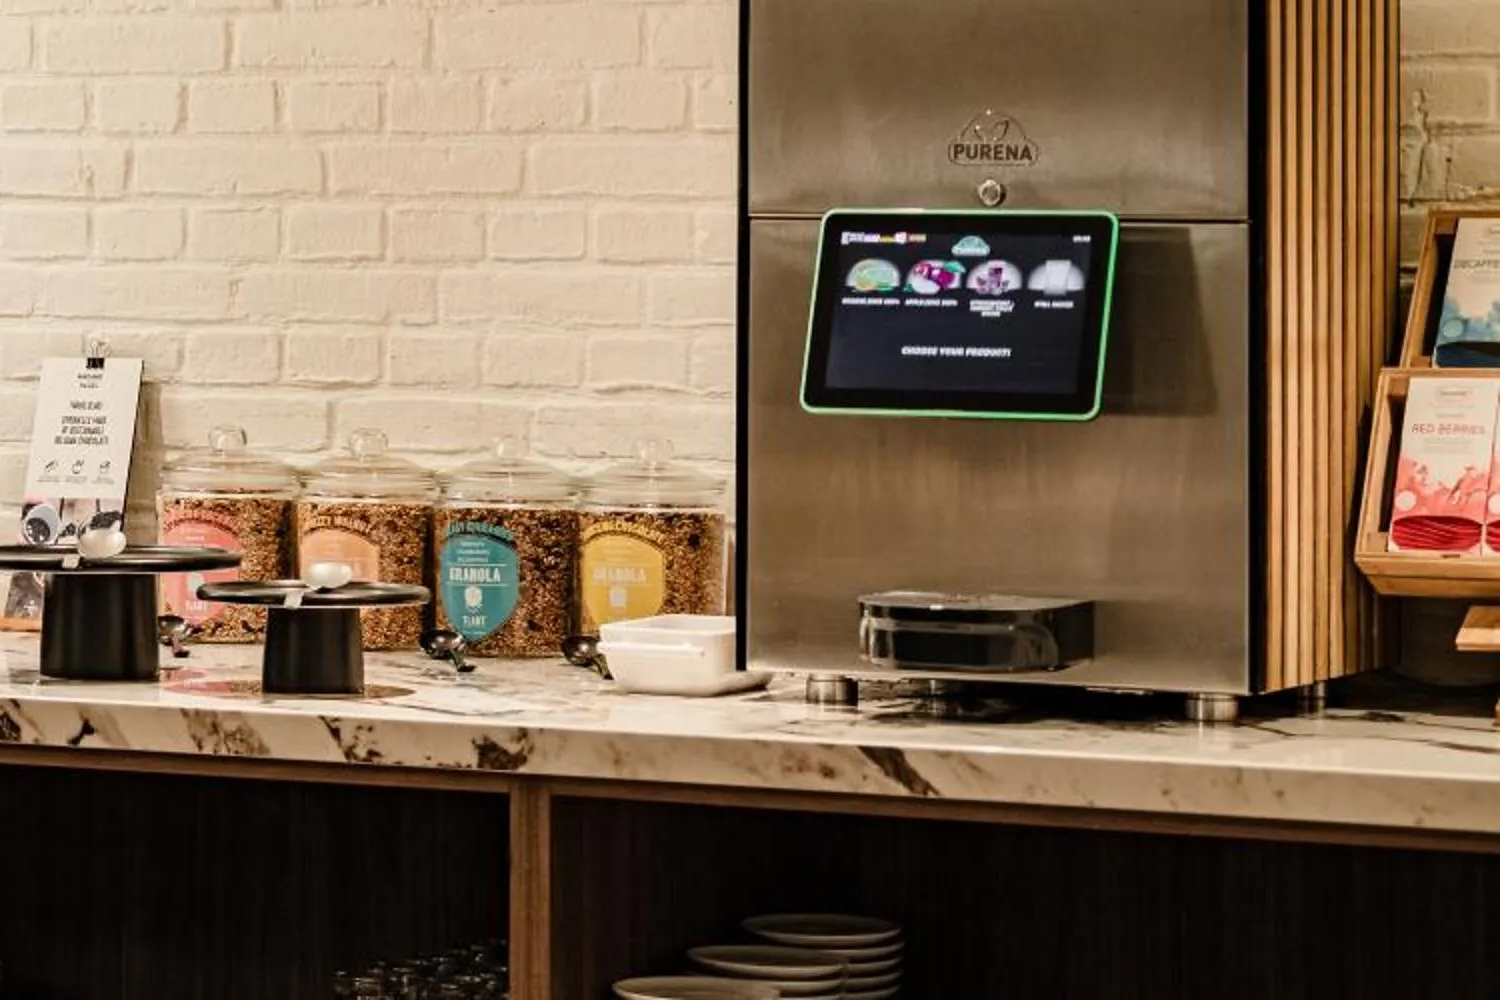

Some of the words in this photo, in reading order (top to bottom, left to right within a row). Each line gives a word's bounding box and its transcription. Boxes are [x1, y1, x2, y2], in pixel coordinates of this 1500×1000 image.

[953, 143, 1033, 161] PURENA
[1411, 423, 1436, 433] RED
[1438, 423, 1486, 435] BERRIES
[449, 567, 501, 583] GRANOLA
